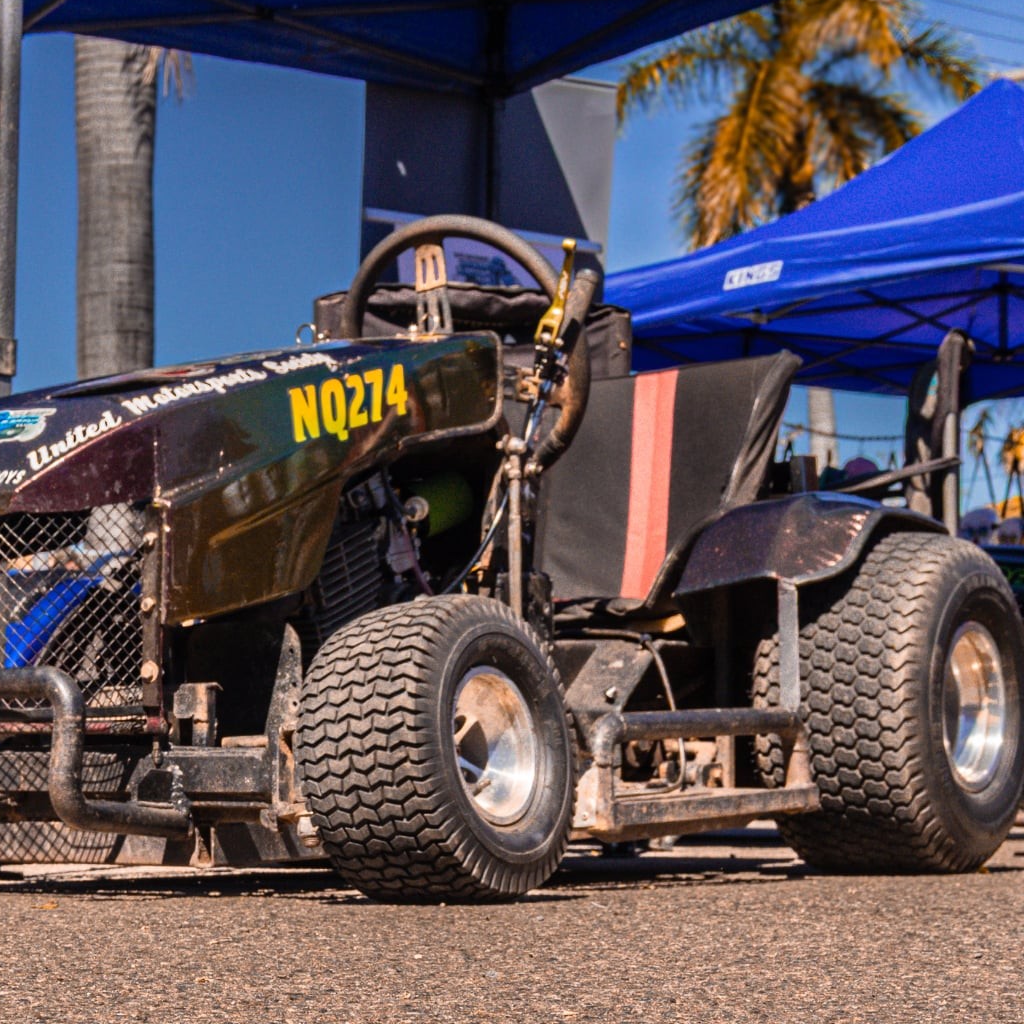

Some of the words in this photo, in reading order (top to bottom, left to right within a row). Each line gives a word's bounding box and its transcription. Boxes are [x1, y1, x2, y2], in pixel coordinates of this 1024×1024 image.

[26, 410, 123, 472] United
[121, 367, 269, 416] Motorsports
[288, 363, 409, 443] NQ274
